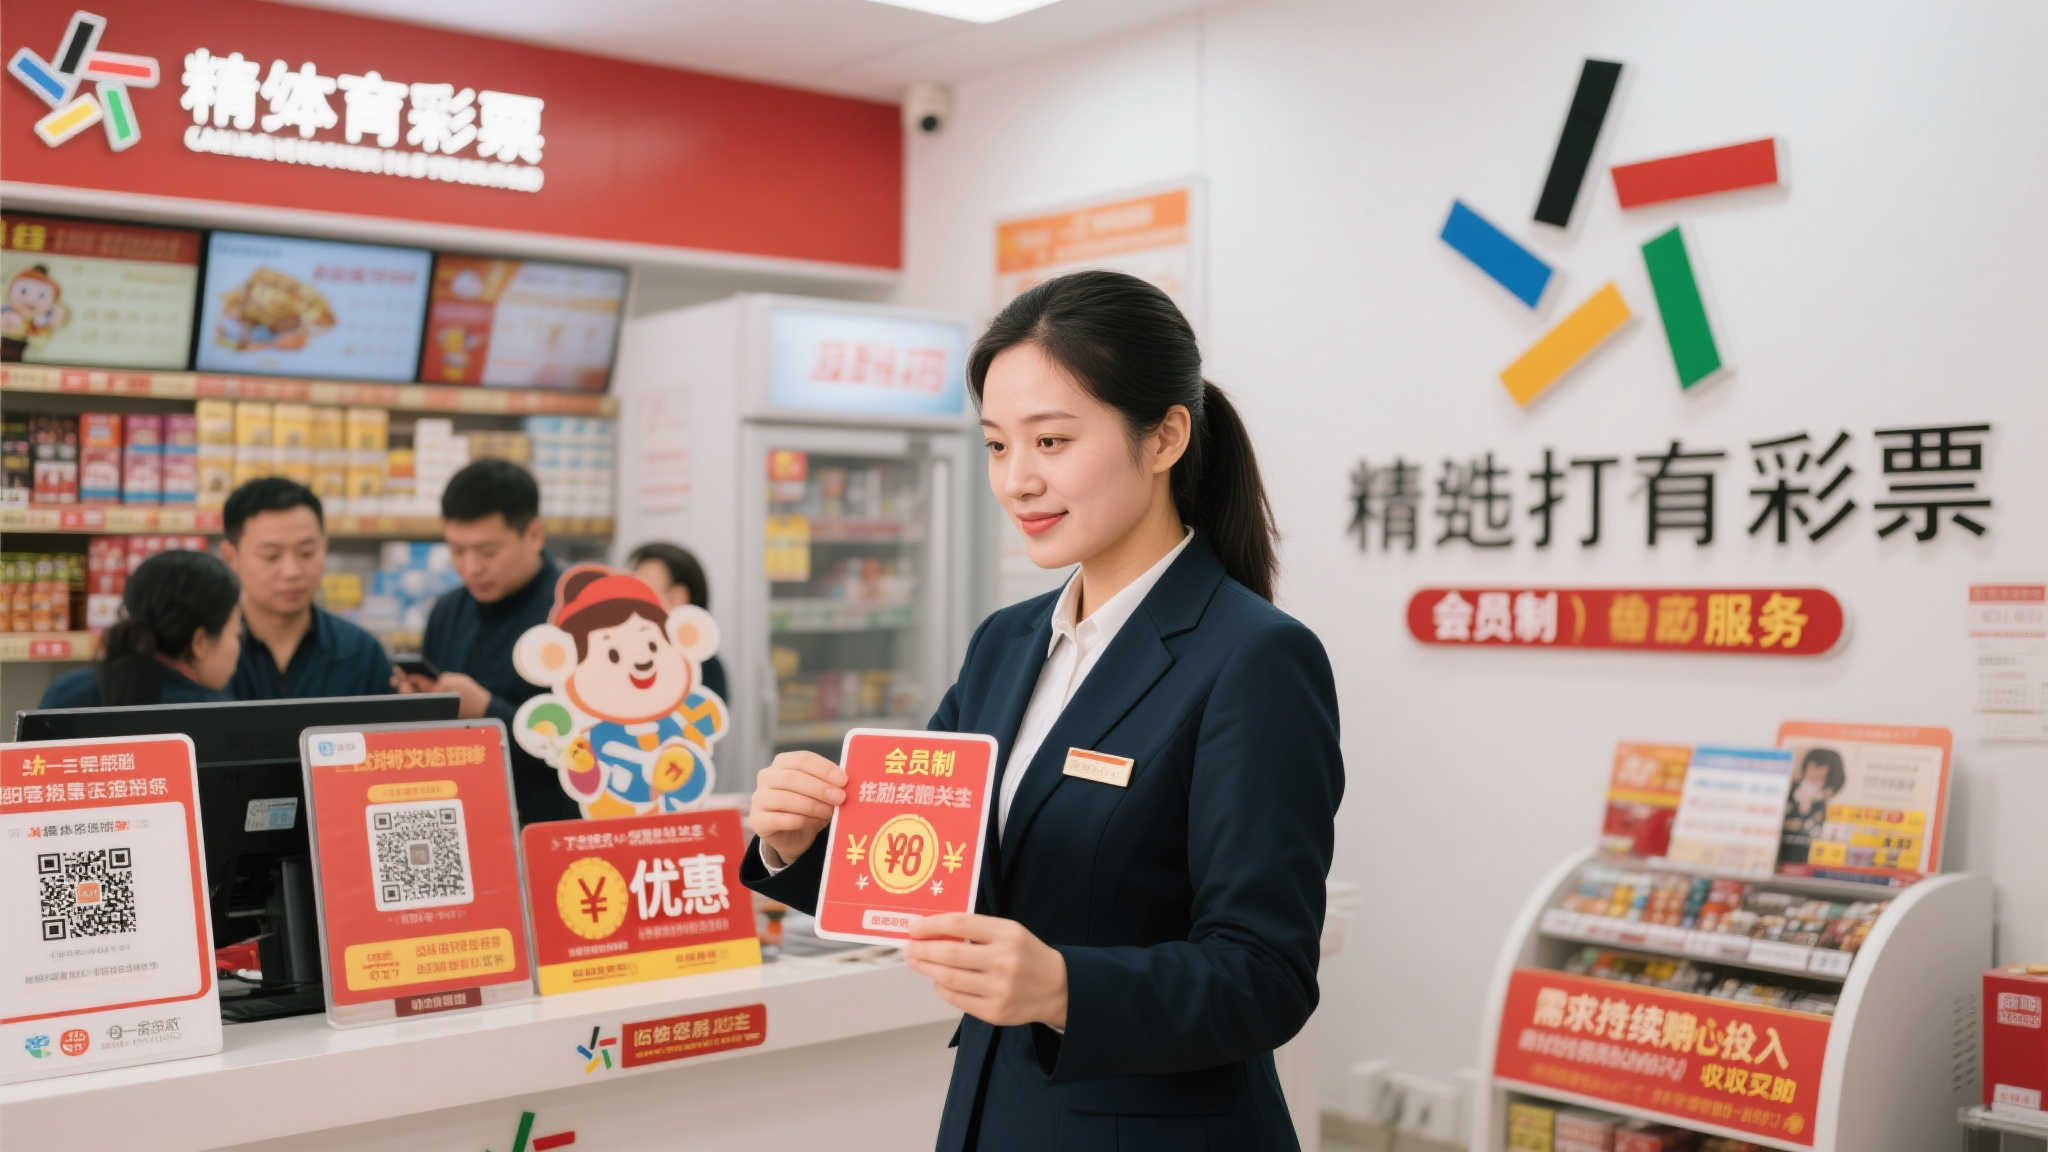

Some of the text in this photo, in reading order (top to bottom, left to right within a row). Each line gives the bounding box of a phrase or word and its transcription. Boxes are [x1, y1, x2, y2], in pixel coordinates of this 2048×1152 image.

[884, 747, 956, 778] 会员制
[629, 852, 731, 921] 优惠
